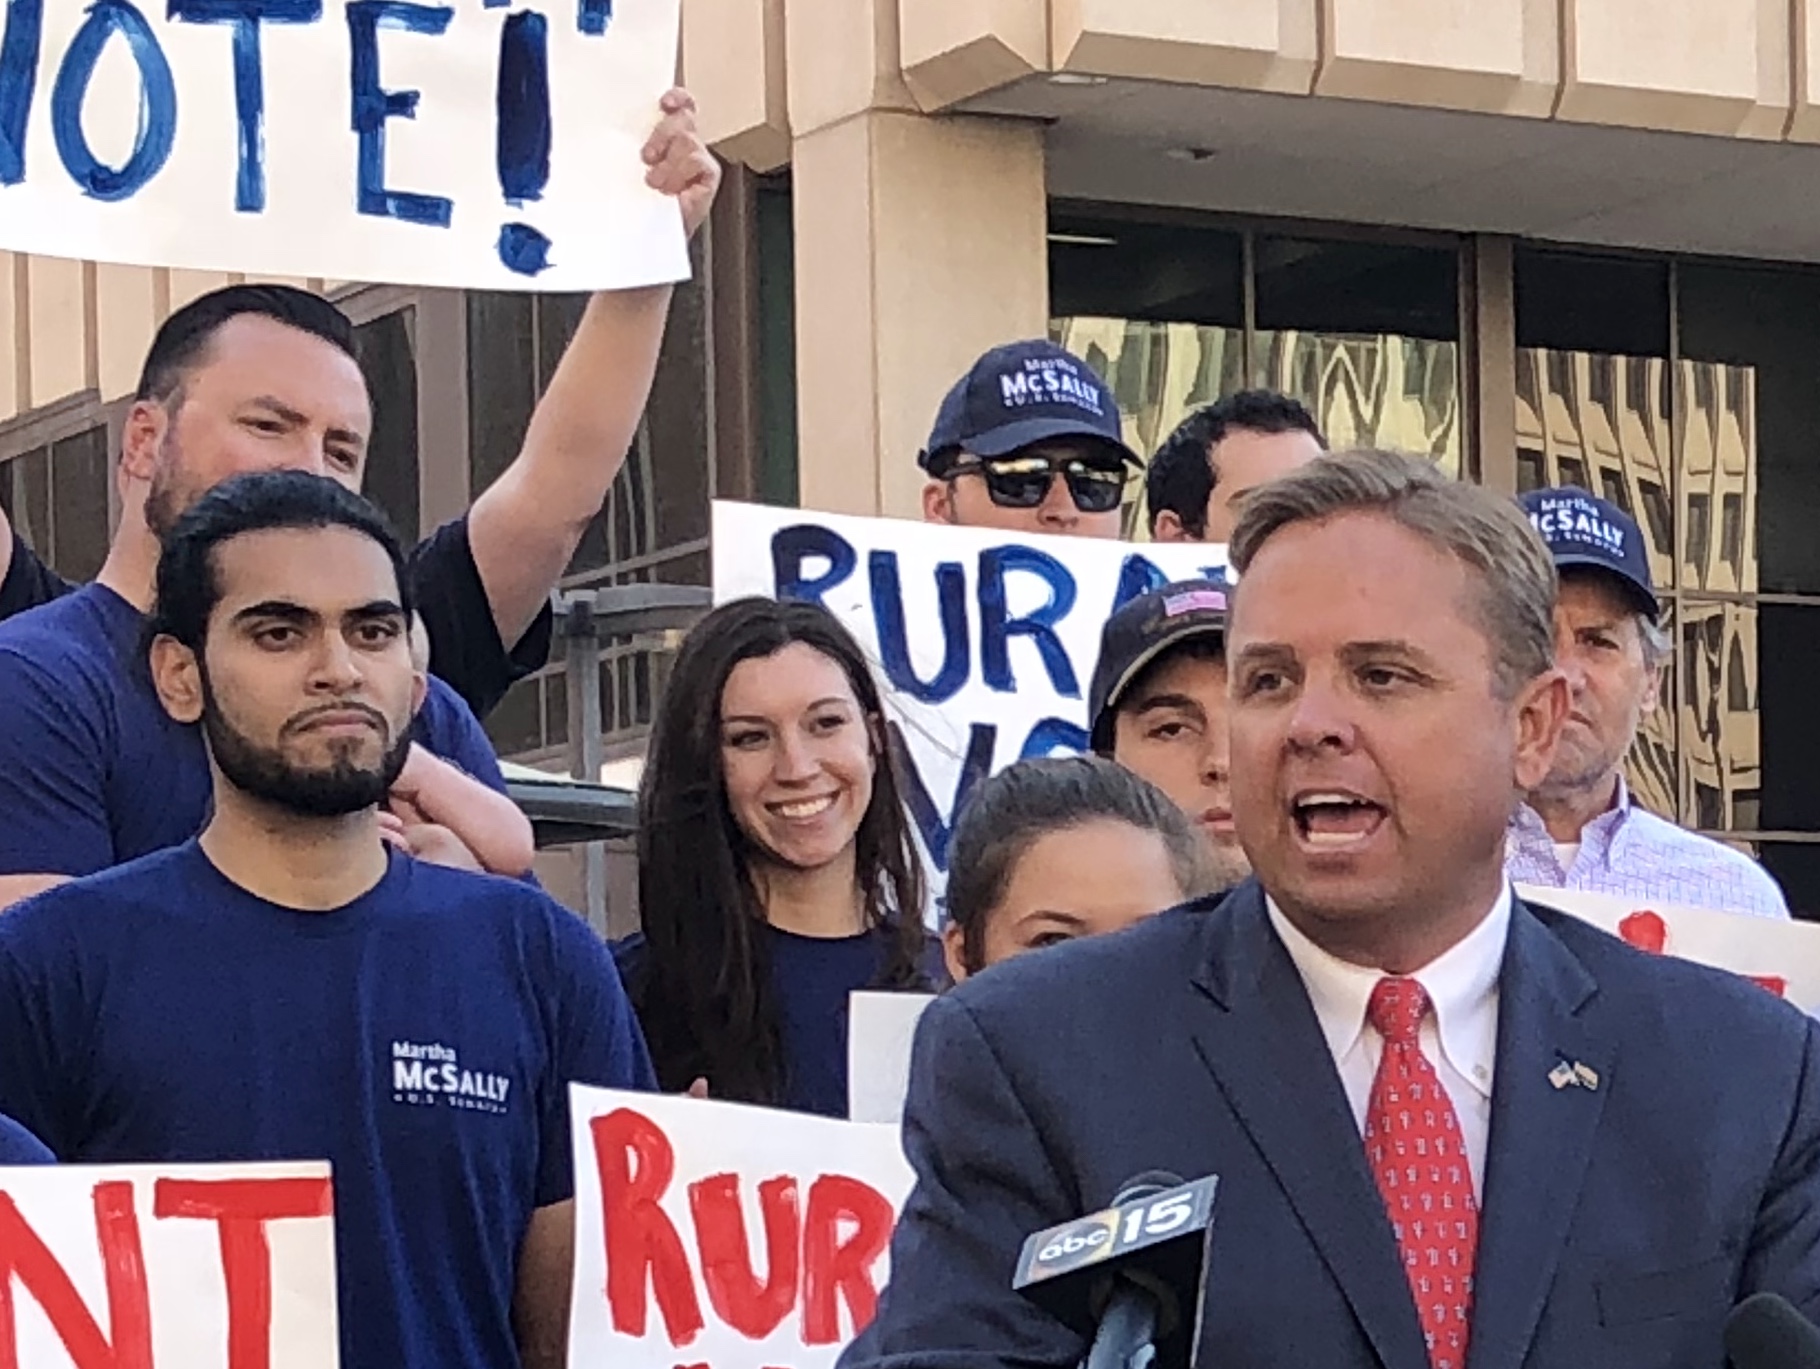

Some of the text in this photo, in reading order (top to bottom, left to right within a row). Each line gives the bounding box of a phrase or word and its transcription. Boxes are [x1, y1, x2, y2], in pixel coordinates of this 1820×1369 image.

[392, 1040, 457, 1062] Martha
[393, 1060, 510, 1102] McSALLY
[1038, 1191, 1193, 1262] abc 15
